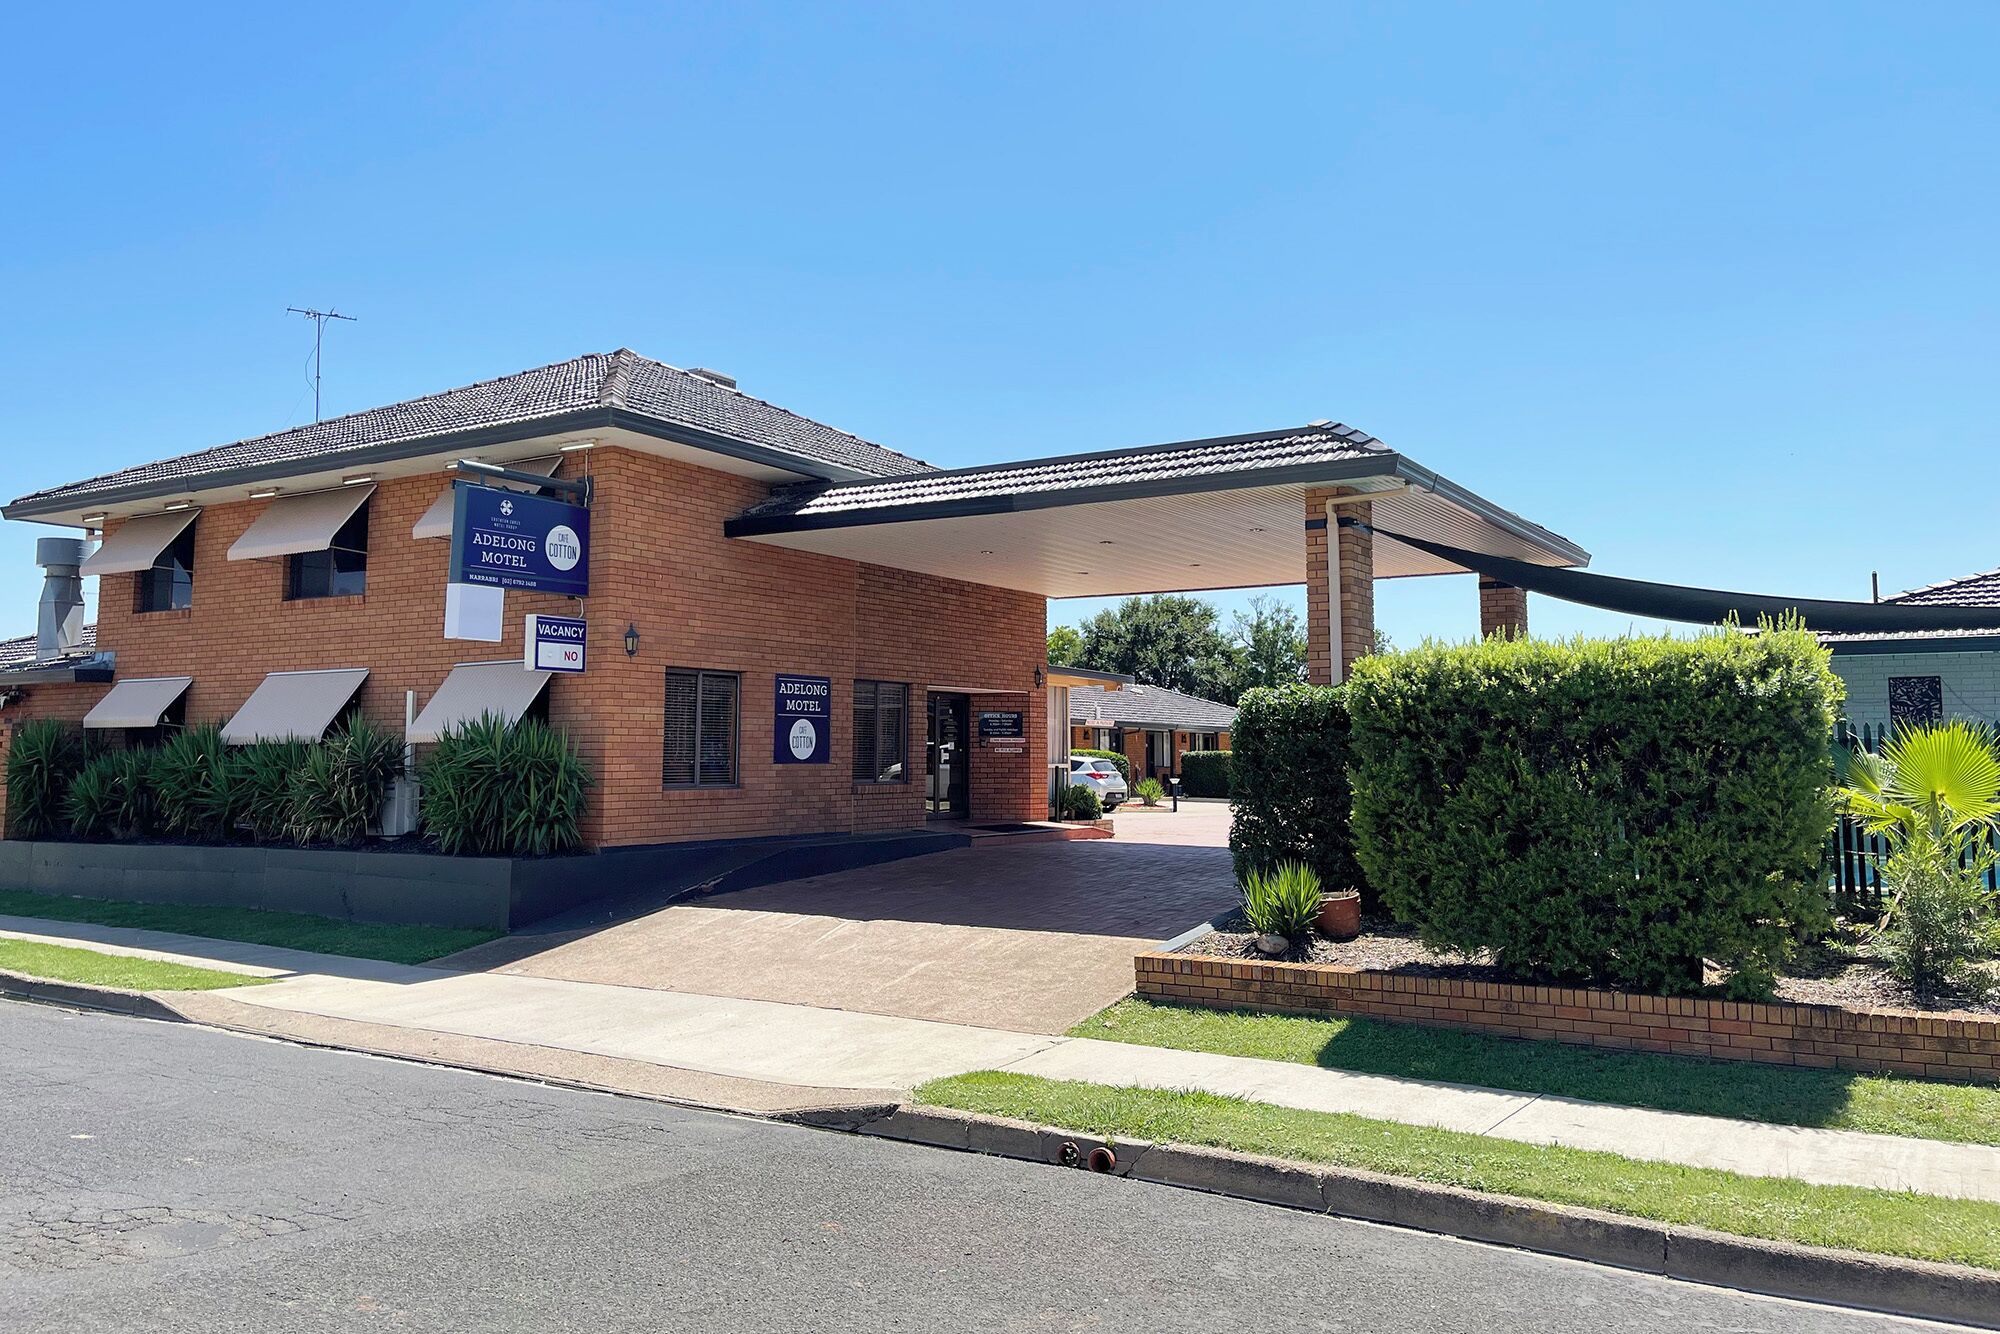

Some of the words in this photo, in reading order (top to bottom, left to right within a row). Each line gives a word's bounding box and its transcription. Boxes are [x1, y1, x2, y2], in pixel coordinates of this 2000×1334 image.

[473, 533, 536, 552] ADELONG
[549, 543, 577, 560] COTTON
[481, 551, 527, 567] MOTEL
[538, 623, 584, 638] VACANCY
[564, 651, 578, 661] NO
[779, 683, 828, 696] ADELONG
[786, 700, 821, 711] MOTEL
[792, 736, 814, 749] COTTON
